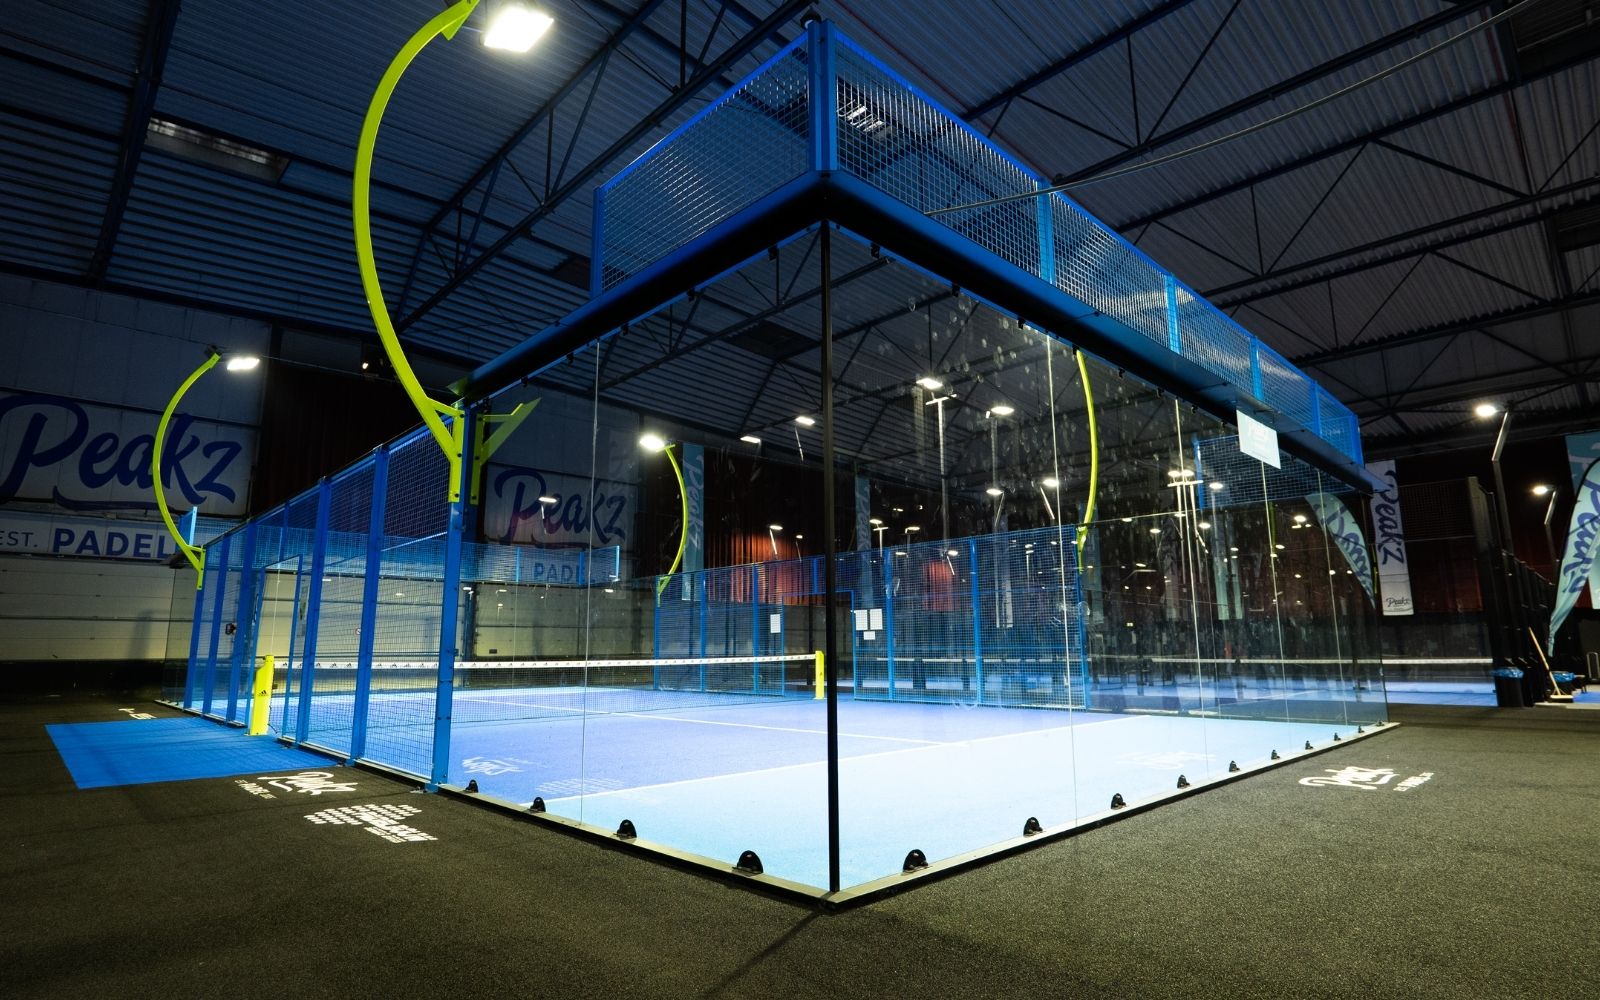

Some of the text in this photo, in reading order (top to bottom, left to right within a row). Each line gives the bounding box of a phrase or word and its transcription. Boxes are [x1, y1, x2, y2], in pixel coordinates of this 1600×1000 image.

[0, 394, 242, 506] Peakz
[495, 468, 626, 546] Peakz
[53, 528, 170, 559] PADEL
[533, 562, 597, 585] PAD
